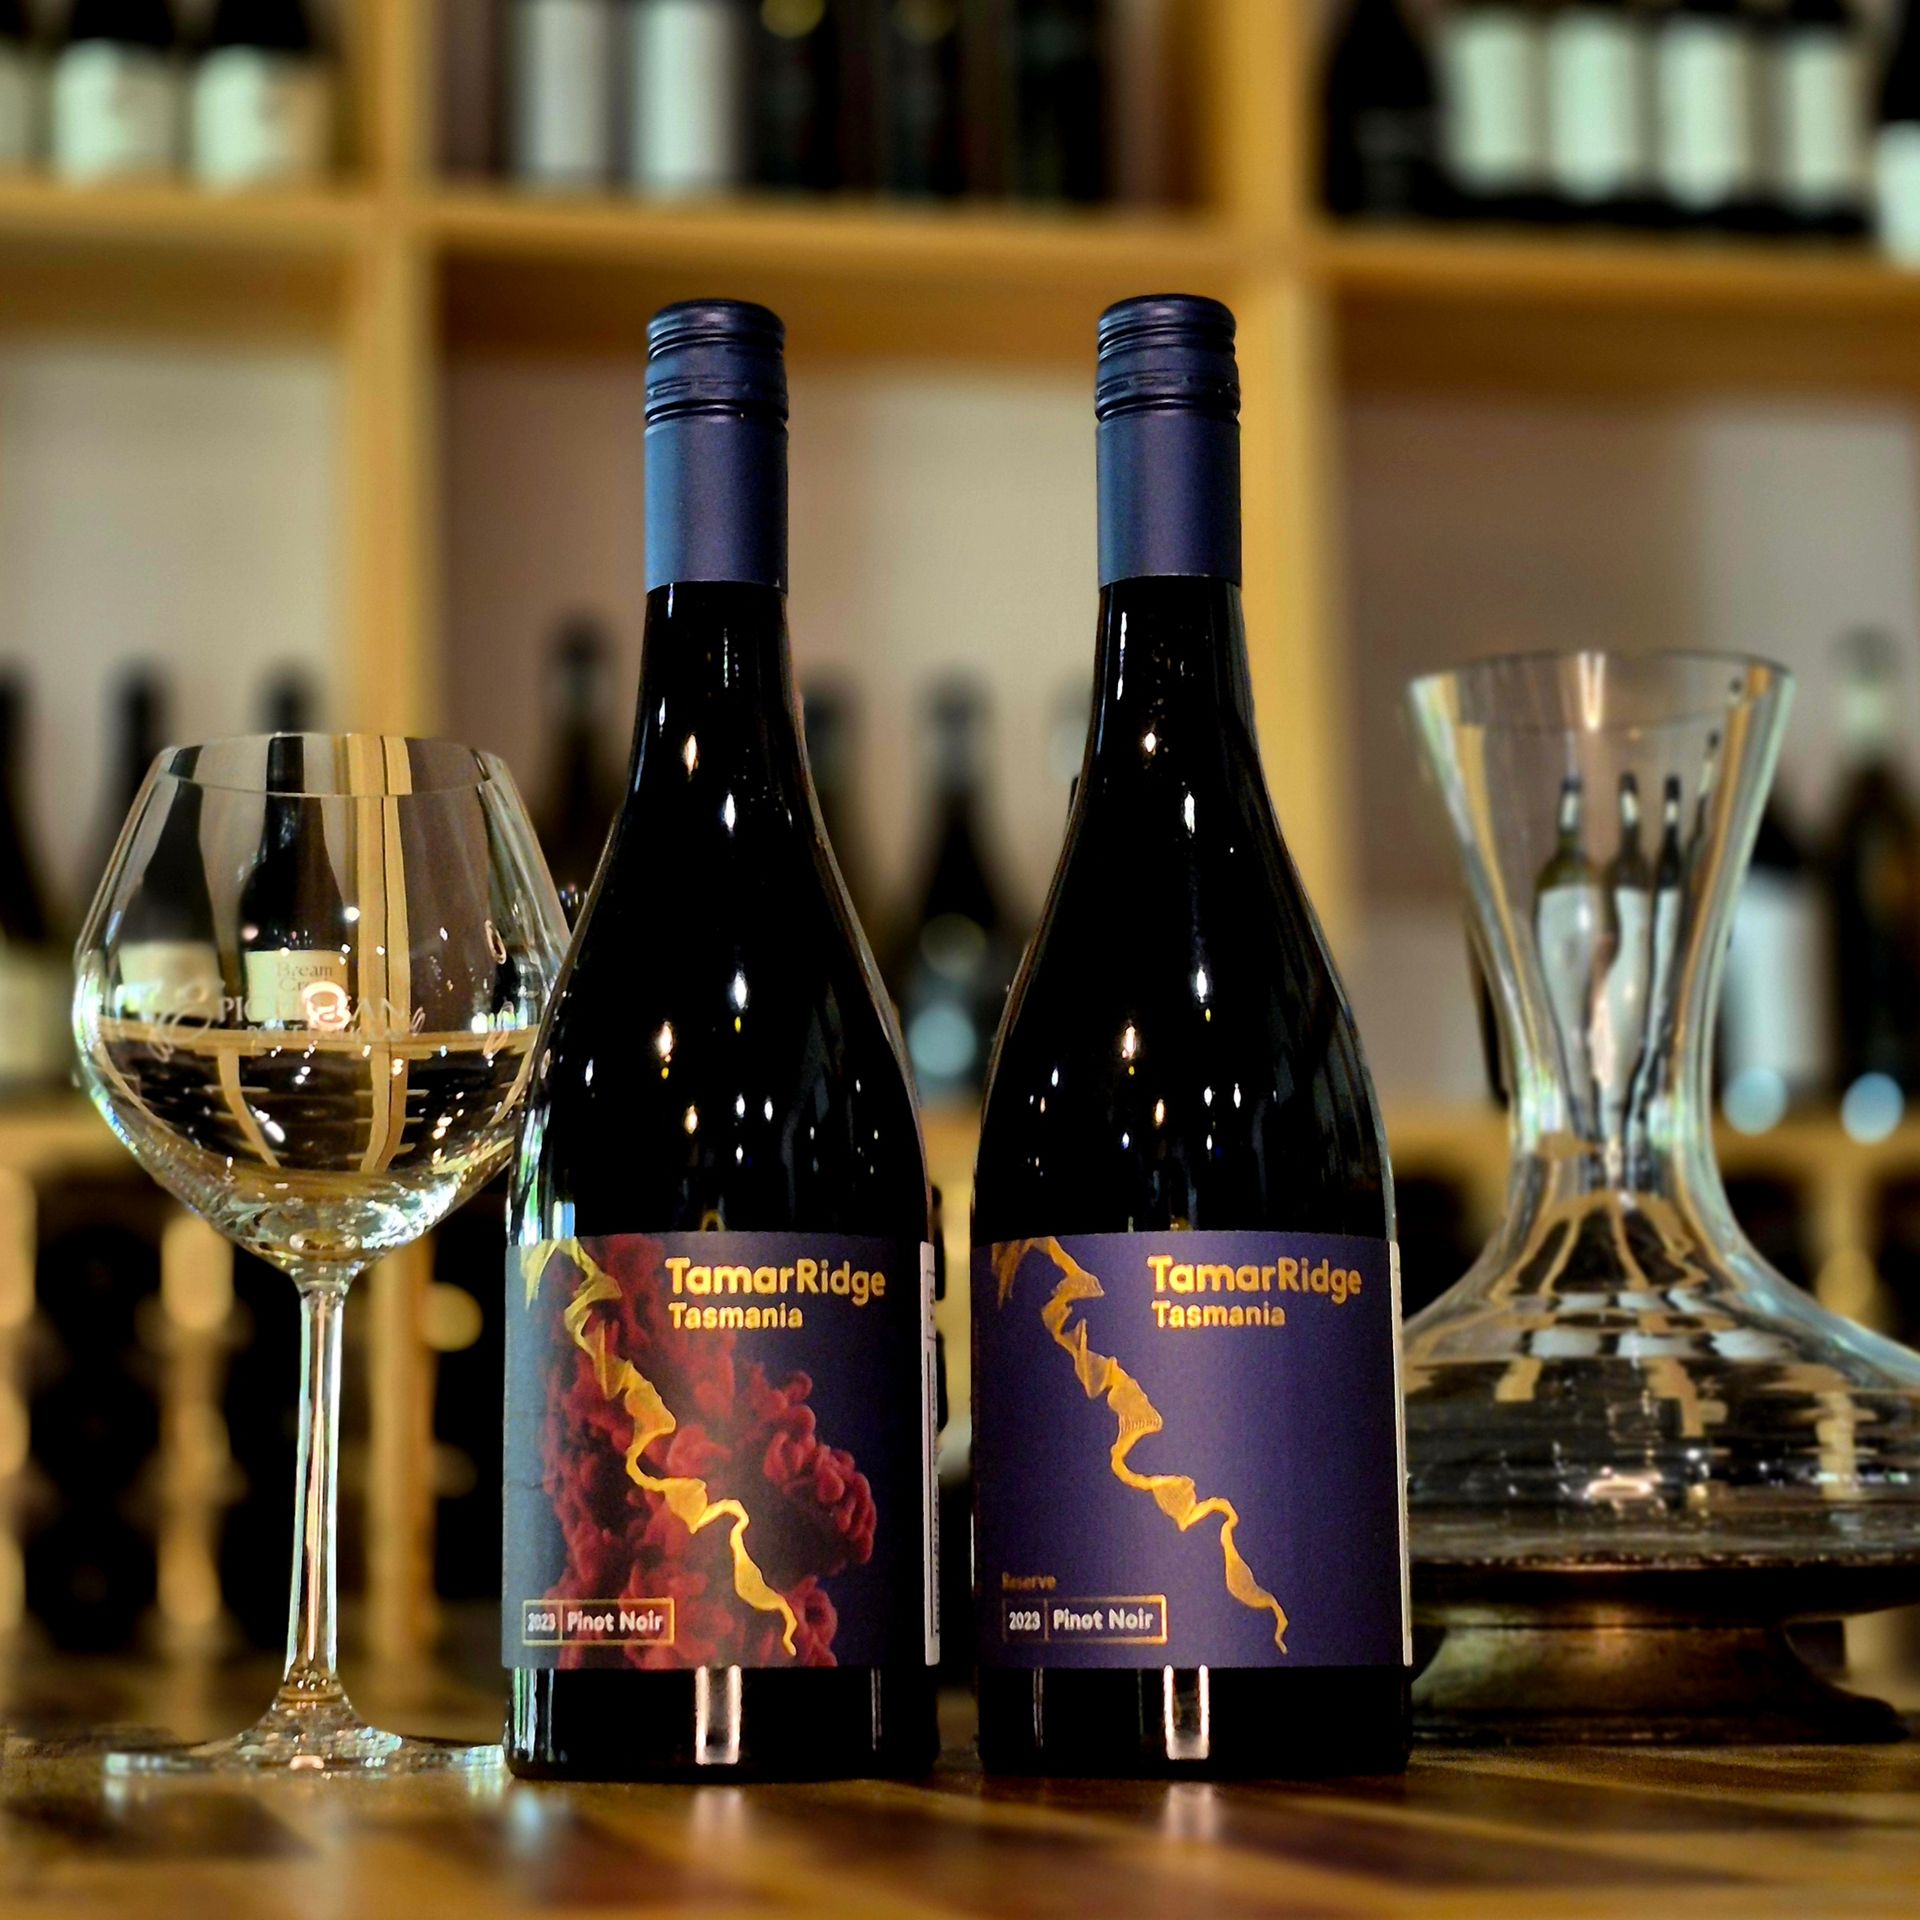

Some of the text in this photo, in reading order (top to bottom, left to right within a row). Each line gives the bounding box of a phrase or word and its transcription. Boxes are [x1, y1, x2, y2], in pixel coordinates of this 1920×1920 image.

[665, 1257, 886, 1306] TamarRidge
[1147, 1255, 1362, 1304] TamarRidge
[668, 1302, 804, 1329] Tasmania
[1152, 1300, 1286, 1328] Tasmania
[527, 1609, 663, 1632] 2023 Pinot Noir
[1009, 1607, 1154, 1631] 2023 Pinot Noir
